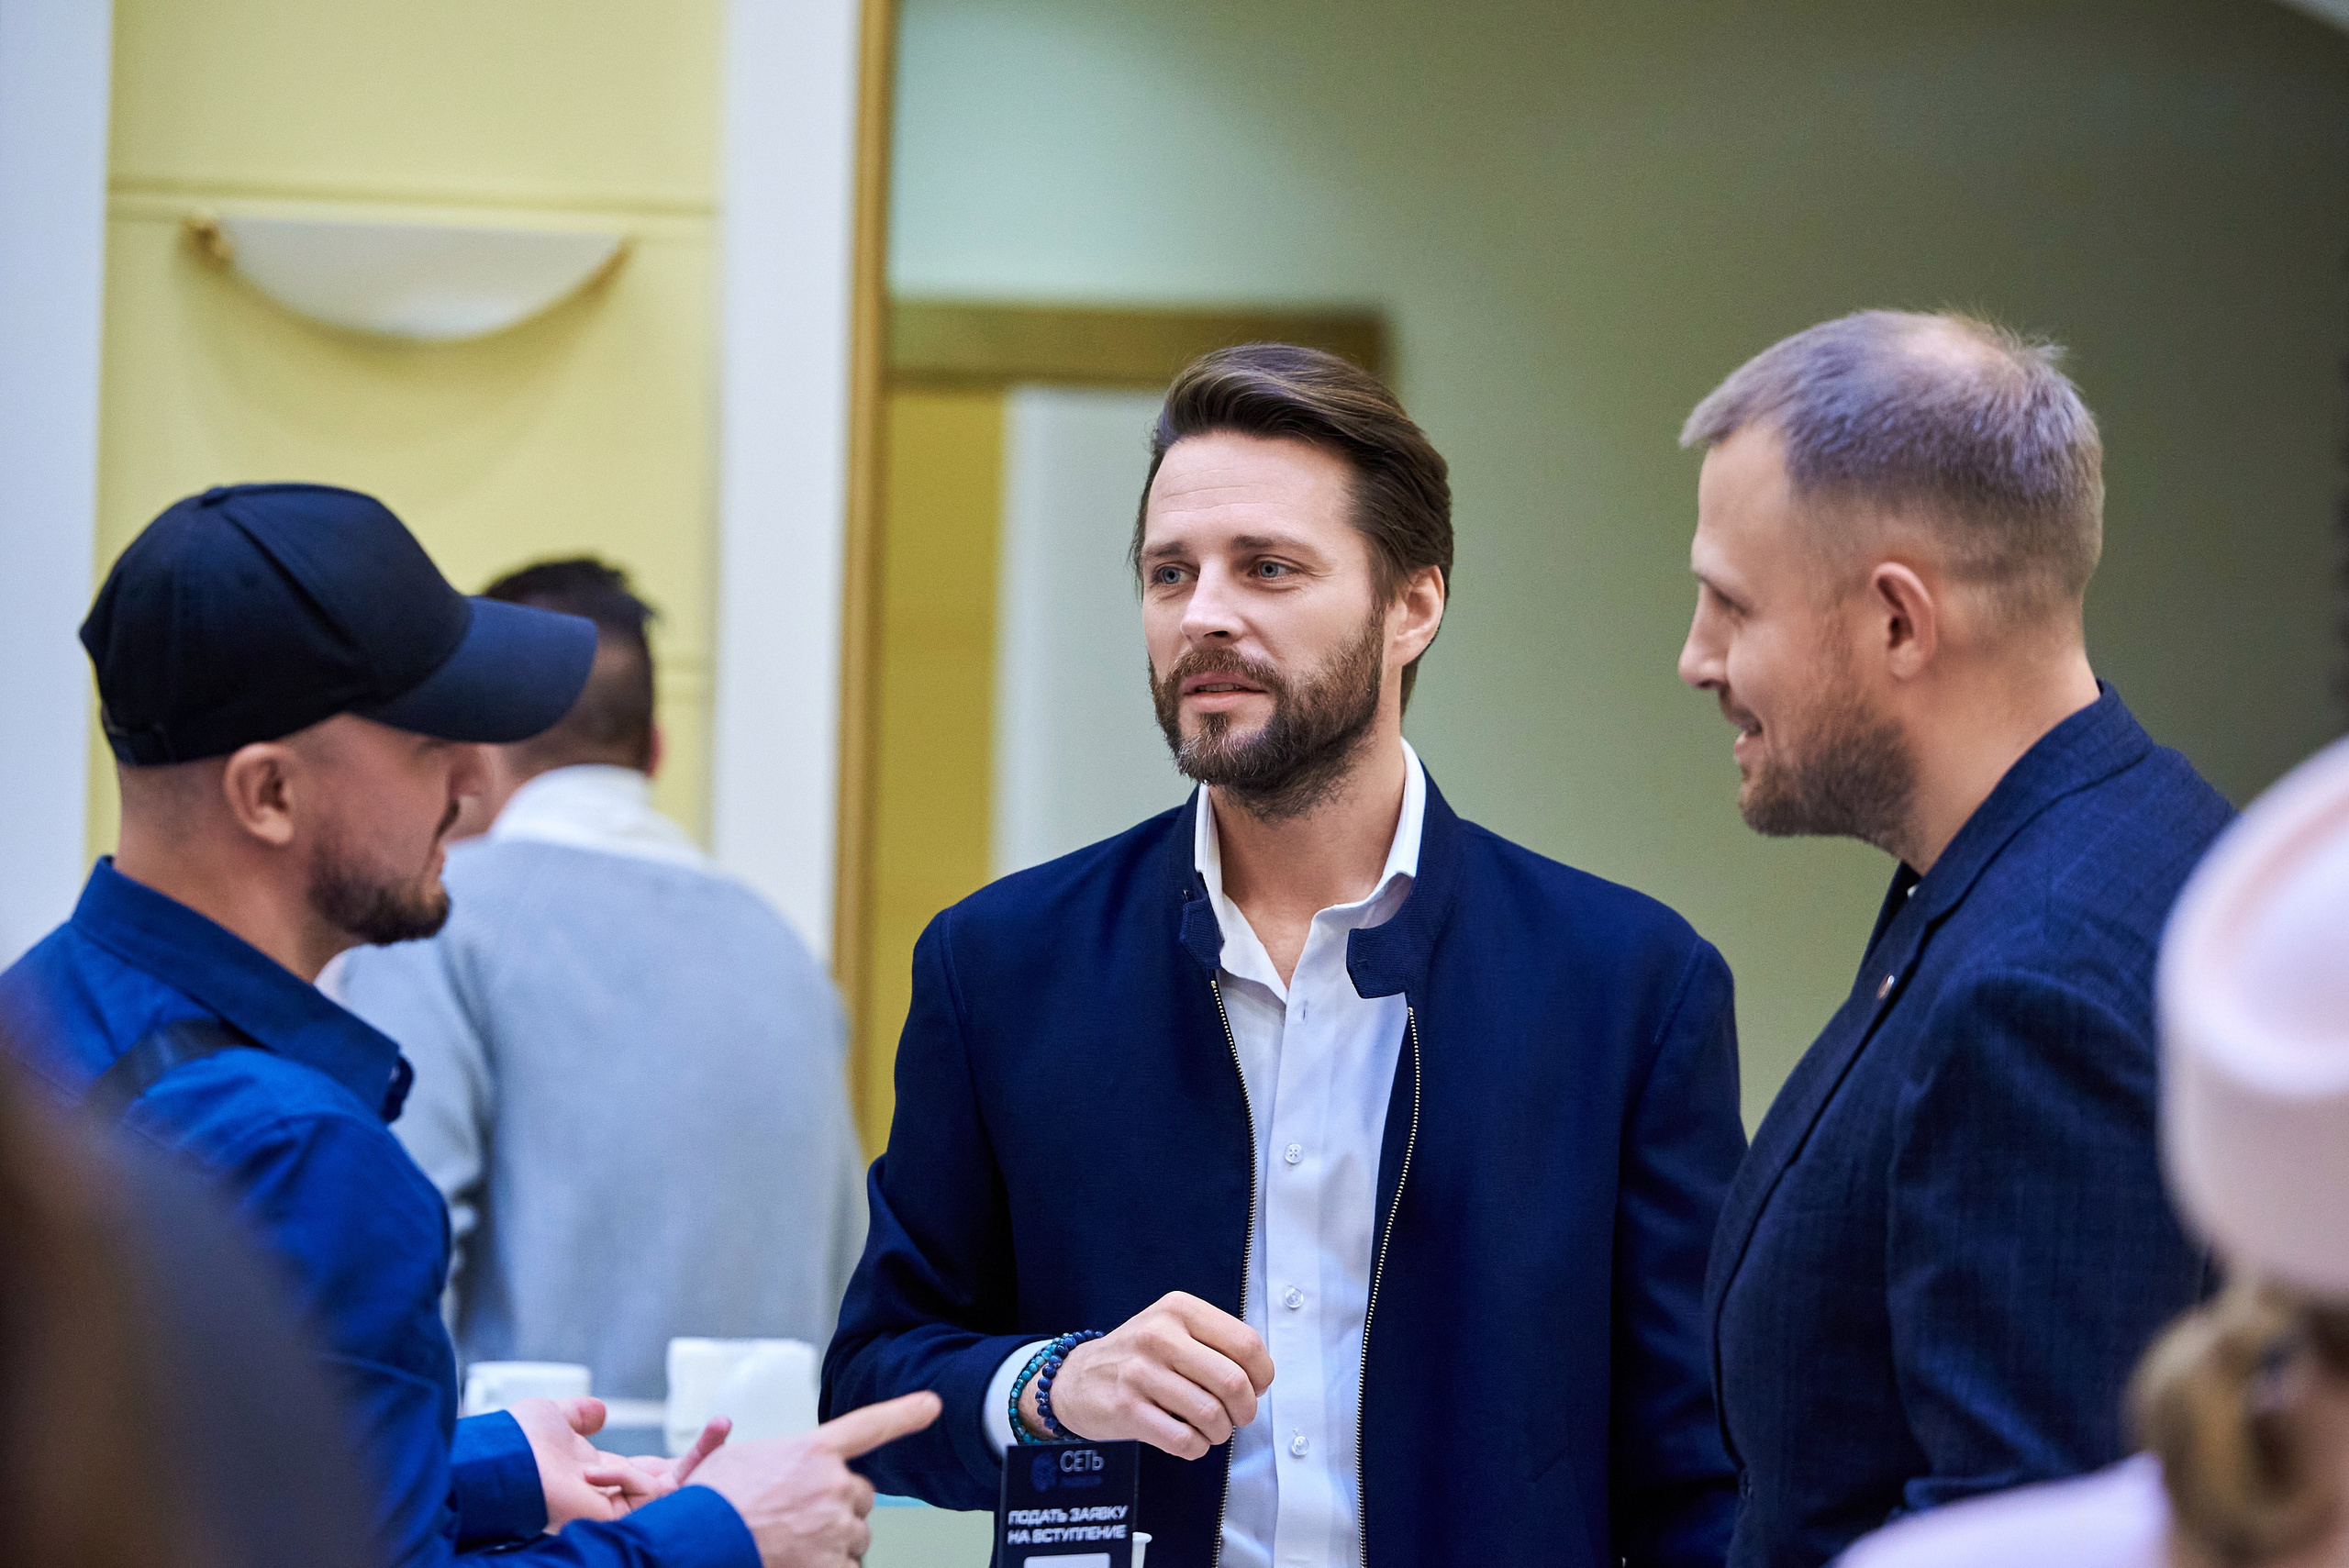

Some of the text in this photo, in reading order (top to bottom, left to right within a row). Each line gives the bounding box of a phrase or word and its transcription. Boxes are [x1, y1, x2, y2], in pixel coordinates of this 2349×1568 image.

[1060, 1450, 1105, 1473] СЕТЬ
[1008, 1505, 1129, 1527] ПОДАТЬ ЗАЯВКУ
[1007, 1525, 1128, 1545] НА ВСТУПЛЕНИЕ
